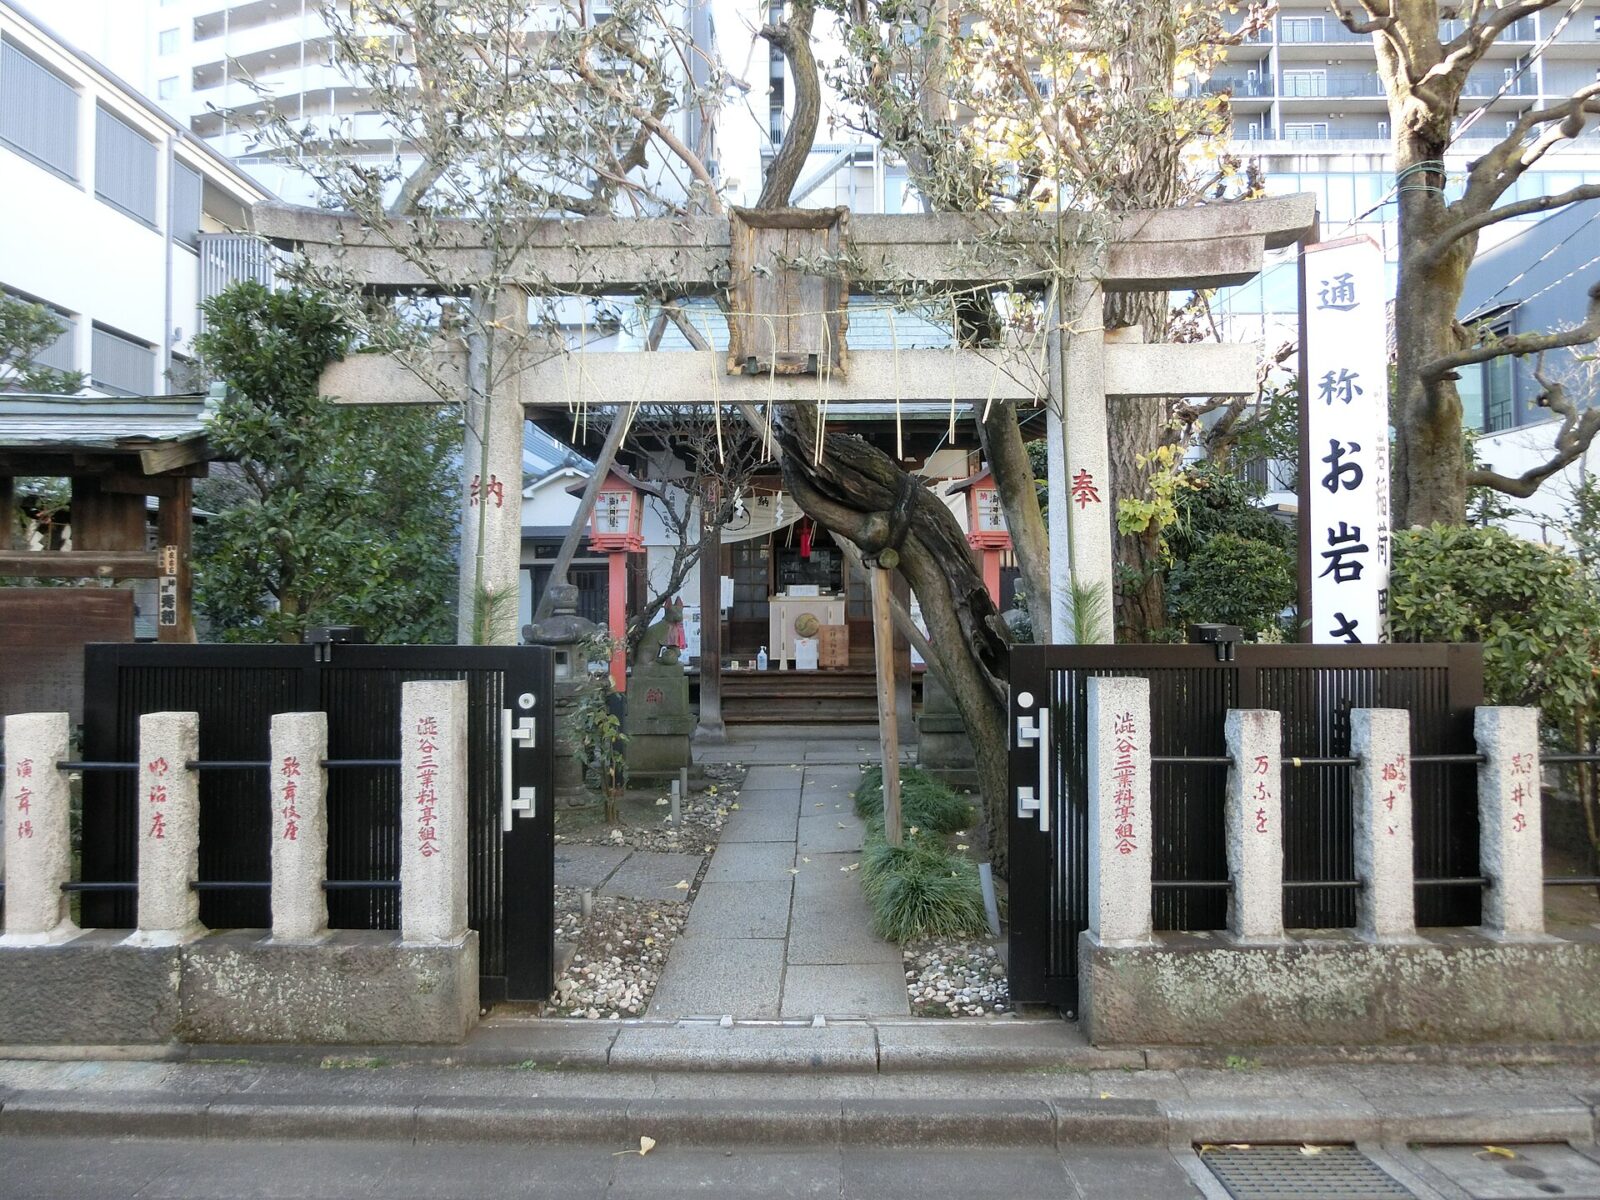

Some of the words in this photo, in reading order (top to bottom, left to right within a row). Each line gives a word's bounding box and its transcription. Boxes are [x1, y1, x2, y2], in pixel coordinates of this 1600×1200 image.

[470, 474, 504, 508] 納
[757, 496, 770, 507] 納
[1071, 468, 1102, 509] 奉
[15, 758, 34, 839] 演舞場
[148, 757, 168, 839] 明治座
[281, 756, 301, 840] 歌舞伎座
